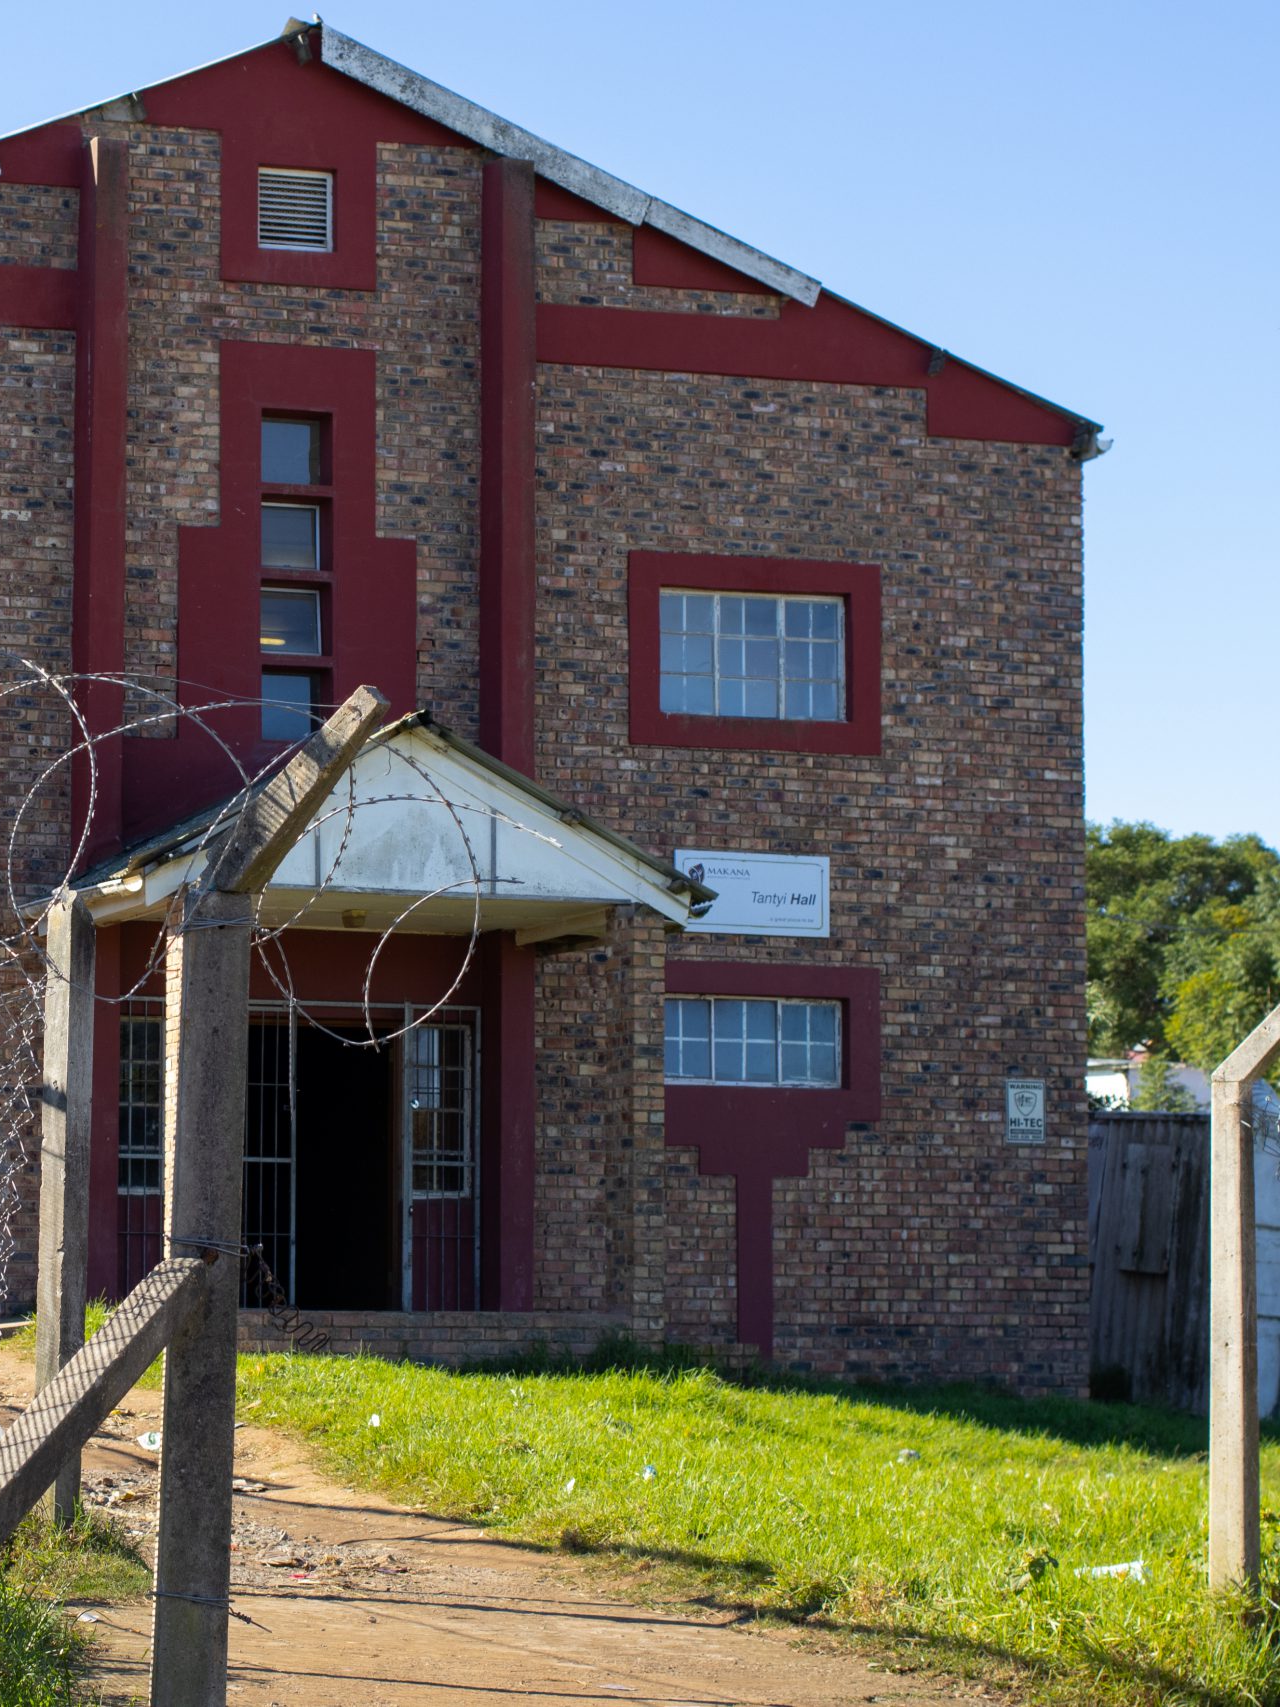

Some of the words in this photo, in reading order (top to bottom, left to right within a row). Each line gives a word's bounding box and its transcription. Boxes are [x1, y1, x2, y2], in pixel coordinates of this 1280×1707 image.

[707, 867, 751, 877] MAKANA
[752, 891, 787, 907] Tantyi
[790, 893, 816, 906] Hall
[1010, 1118, 1042, 1127] HI-TEC
